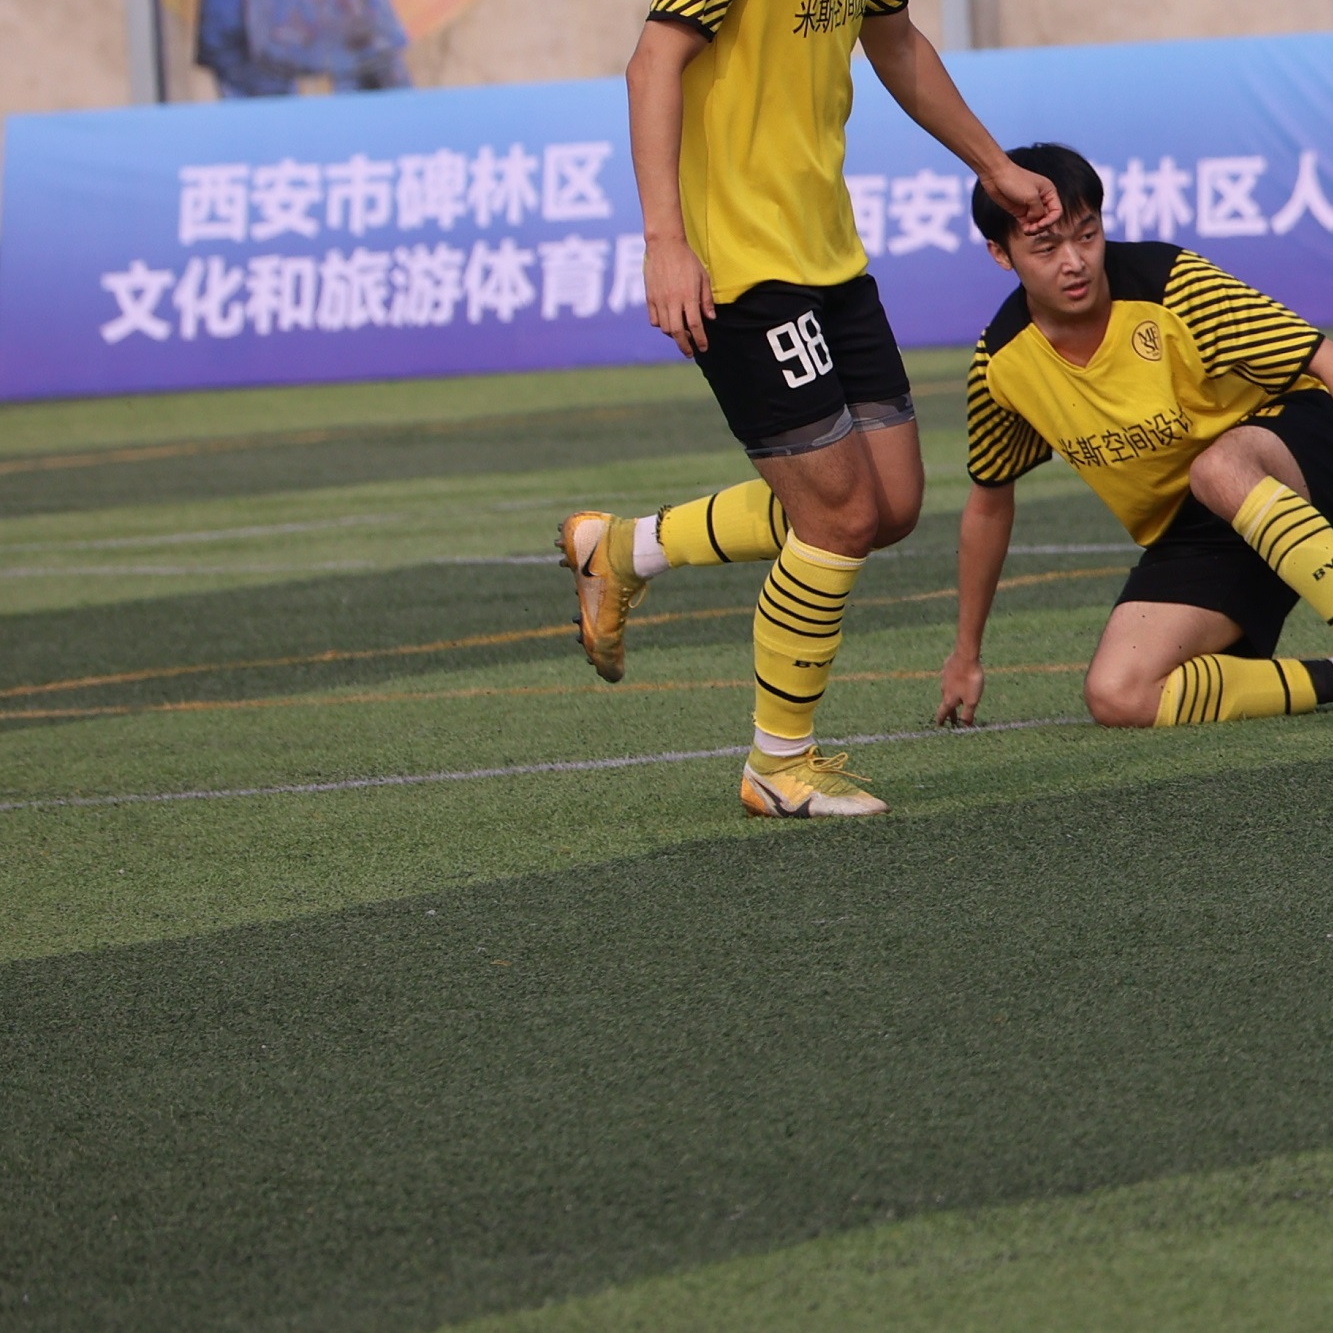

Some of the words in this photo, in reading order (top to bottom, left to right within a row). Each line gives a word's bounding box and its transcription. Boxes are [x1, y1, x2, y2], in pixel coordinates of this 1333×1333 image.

[177, 141, 613, 245] 西安市碑林区
[766, 309, 834, 389] 98
